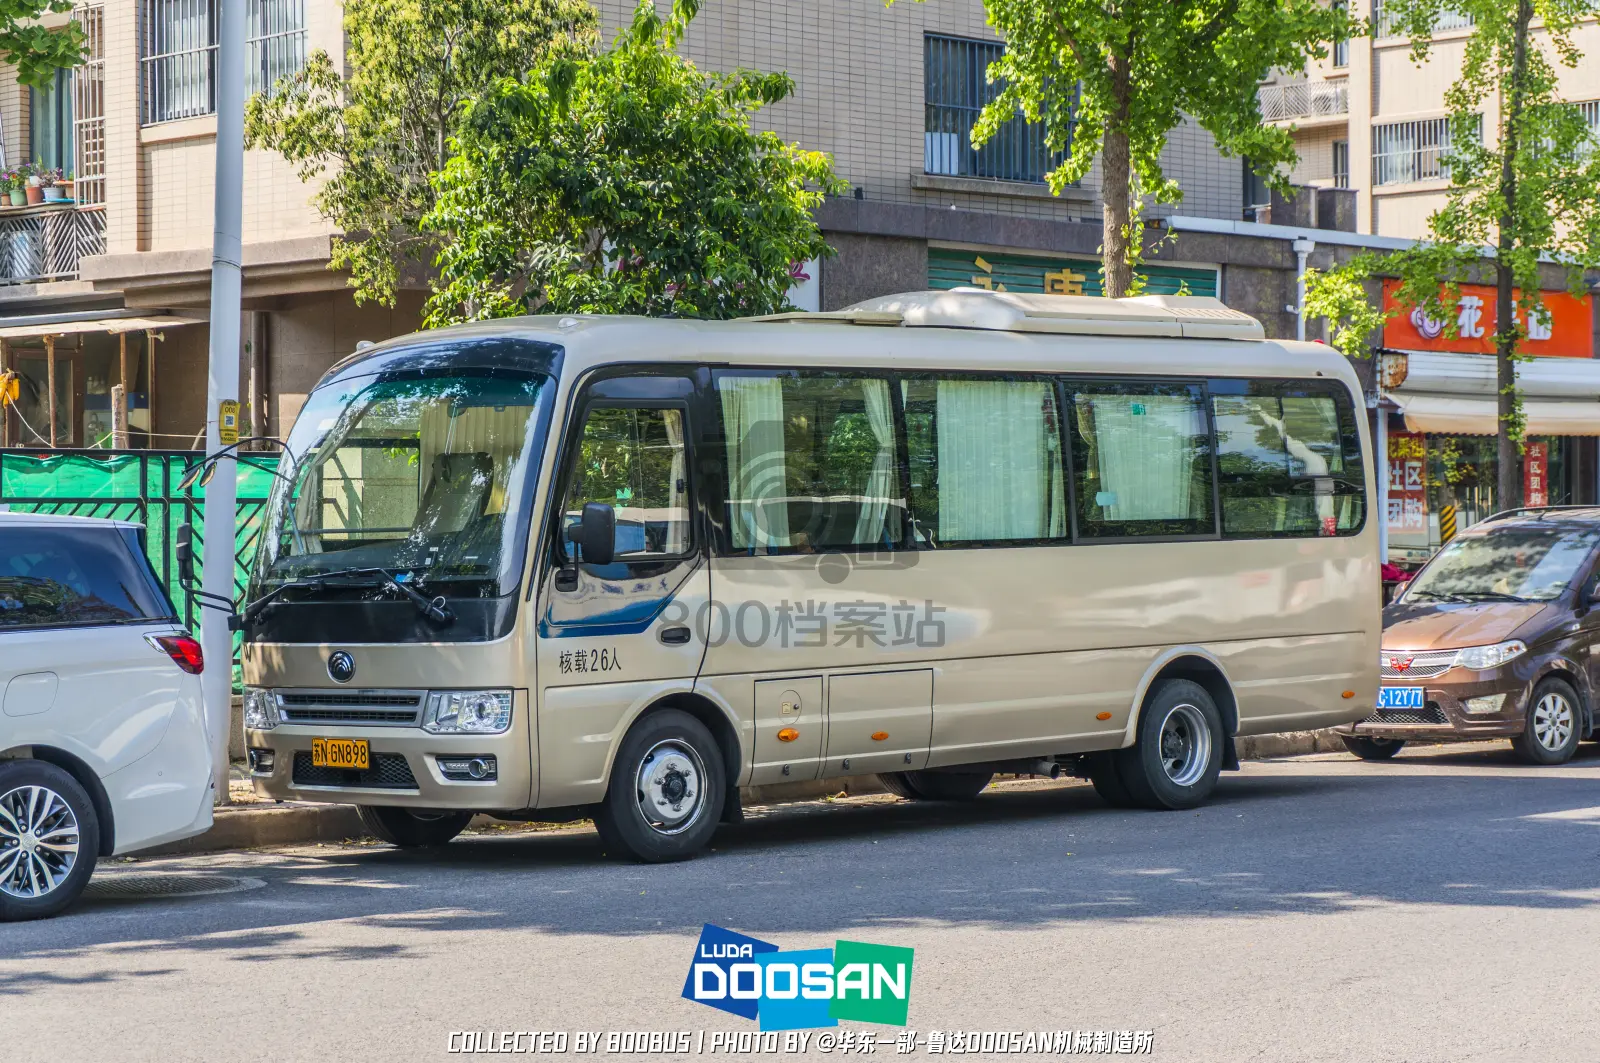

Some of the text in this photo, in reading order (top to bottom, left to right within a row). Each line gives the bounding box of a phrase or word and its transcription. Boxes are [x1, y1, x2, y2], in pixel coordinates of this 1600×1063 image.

[1388, 461, 1422, 491] 社区
[1530, 446, 1541, 505] 社区团购
[1388, 498, 1422, 528] 团购
[559, 647, 622, 674] 核载26人
